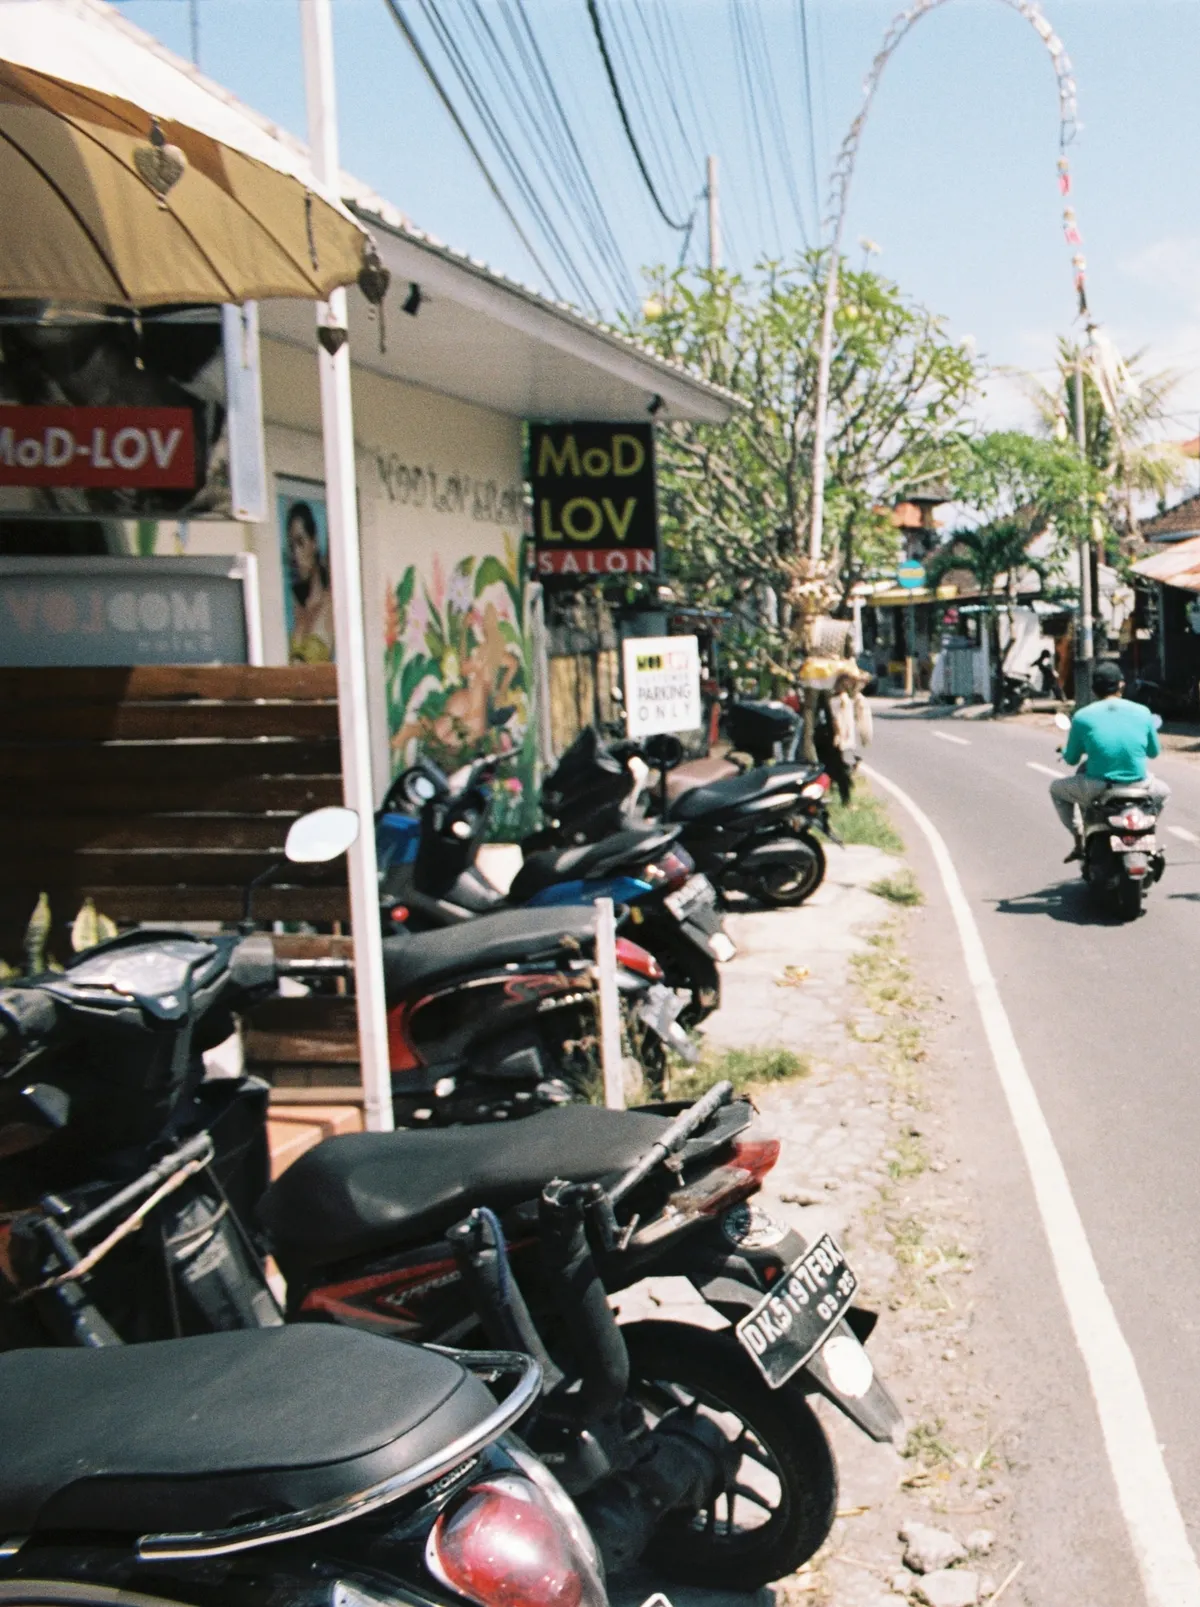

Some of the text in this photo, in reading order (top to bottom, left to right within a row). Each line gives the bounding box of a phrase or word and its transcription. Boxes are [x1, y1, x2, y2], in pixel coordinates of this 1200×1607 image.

[537, 434, 645, 477] MoD
[541, 497, 637, 541] LOV
[538, 551, 656, 574] SALON
[638, 684, 692, 700] PARKING
[639, 702, 690, 721] ONLY
